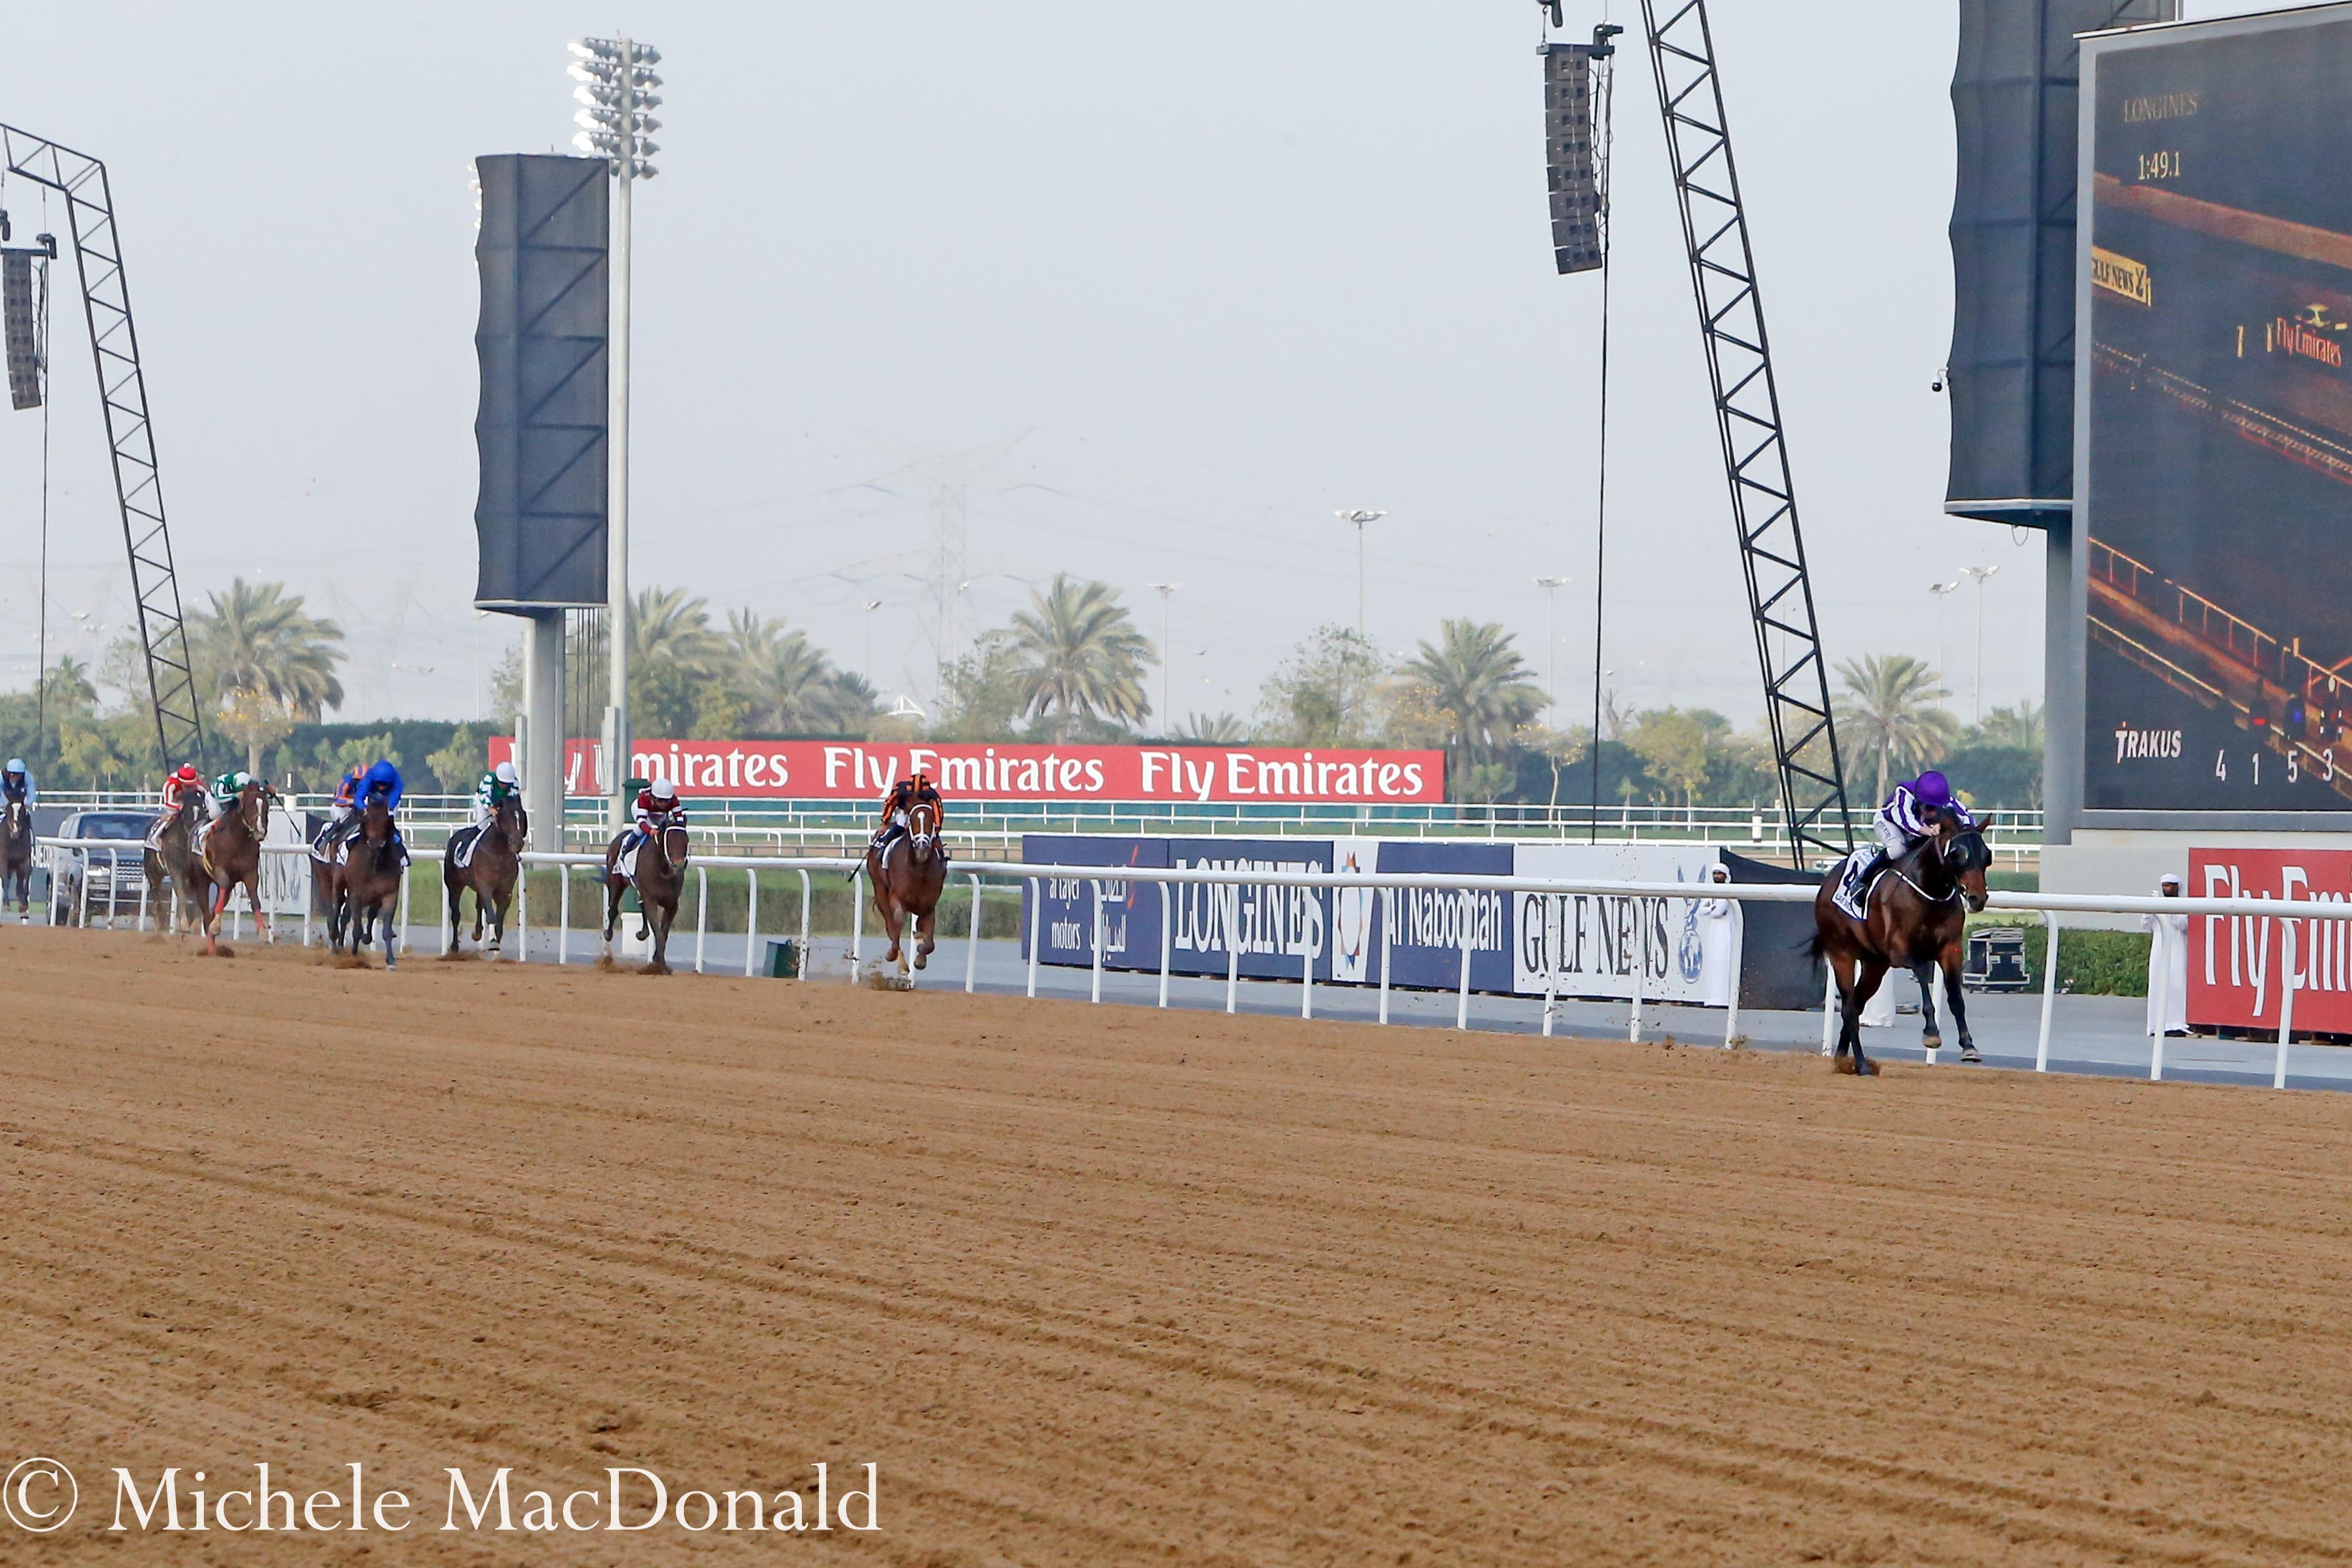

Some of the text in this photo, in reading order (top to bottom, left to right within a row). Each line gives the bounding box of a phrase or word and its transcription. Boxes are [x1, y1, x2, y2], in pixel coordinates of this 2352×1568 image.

[2124, 92, 2198, 123] LONGINES
[2138, 150, 2181, 180] 1:49.1
[2295, 323, 2342, 368] Emirates
[2115, 721, 2182, 763] TRAKUS
[593, 743, 788, 788] mirates
[823, 747, 1104, 798] Fly Emirates
[1140, 751, 1424, 800] Fly Emirates
[2215, 748, 2333, 785] 4 1 5 3
[1175, 857, 1324, 959] LONGINES
[1408, 887, 1502, 951] Naboodah
[1051, 916, 1081, 950] motors
[2203, 864, 2272, 1016] Fly
